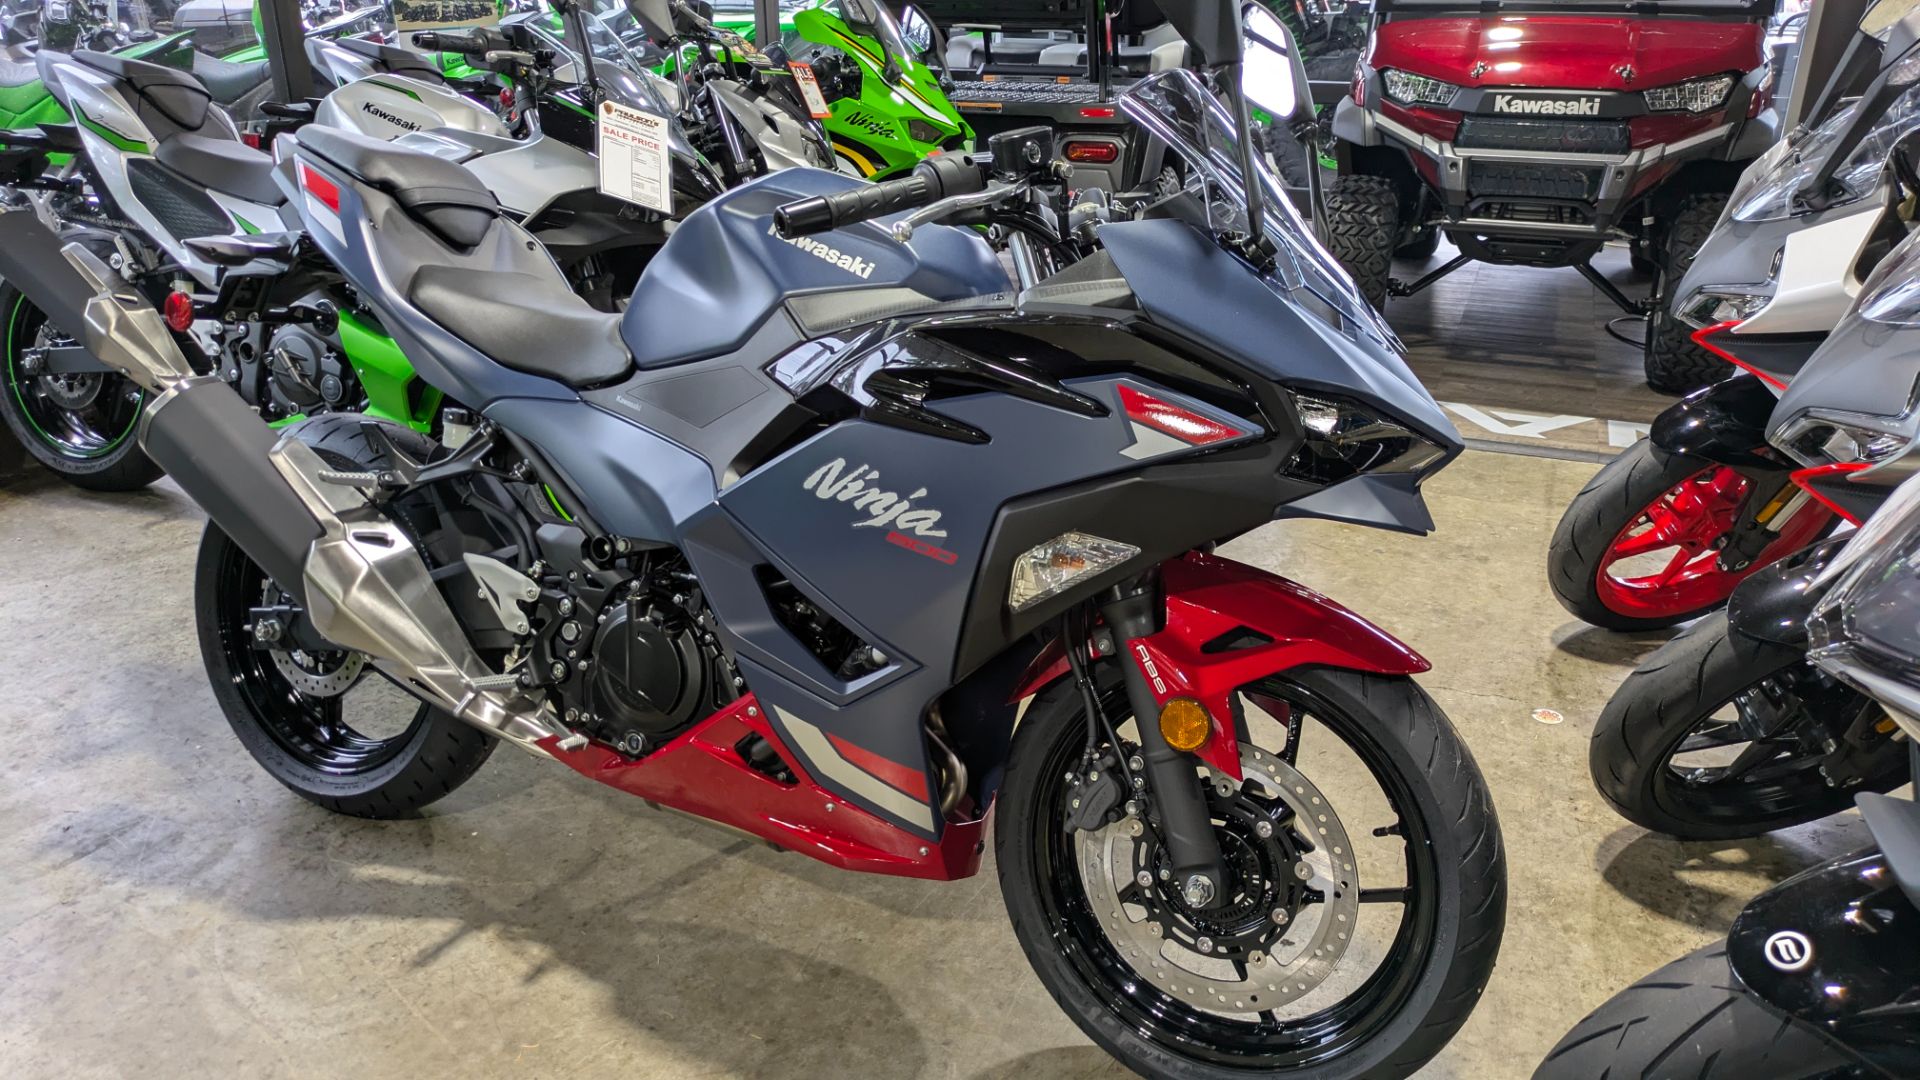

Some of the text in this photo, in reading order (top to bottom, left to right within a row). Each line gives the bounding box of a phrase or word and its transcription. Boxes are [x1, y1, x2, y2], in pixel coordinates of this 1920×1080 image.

[362, 101, 423, 133] Kawasaki
[1493, 94, 1601, 116] Kawasaki
[602, 126, 630, 141] SALE
[631, 135, 661, 152] PRICE
[844, 111, 899, 141] Ninja
[802, 456, 949, 538] Ninja
[1135, 643, 1168, 695] ABS
